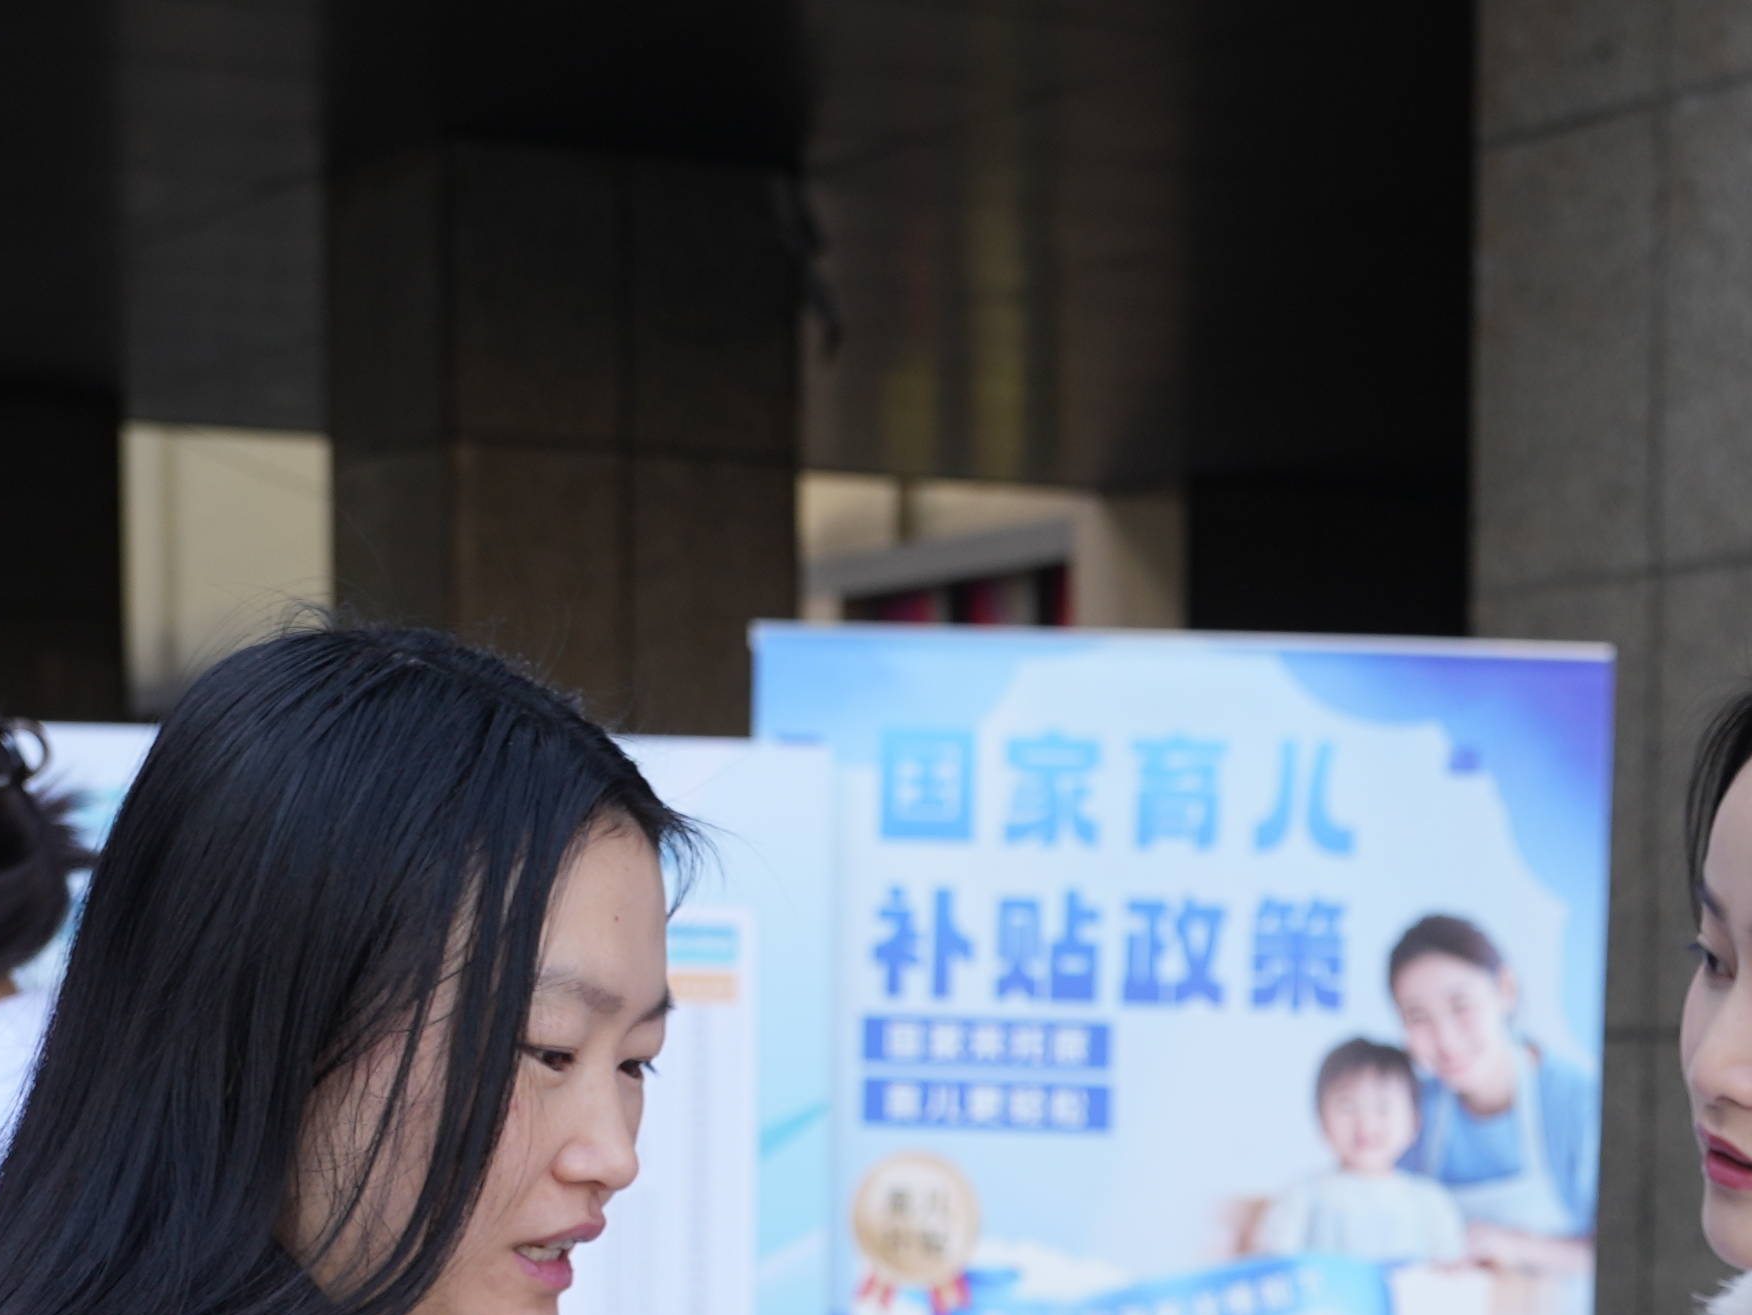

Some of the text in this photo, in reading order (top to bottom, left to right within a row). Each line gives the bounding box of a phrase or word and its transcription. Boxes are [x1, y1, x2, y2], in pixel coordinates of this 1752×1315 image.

[877, 728, 1356, 858] 国家育儿
[870, 885, 1350, 1012] 补贴政策
